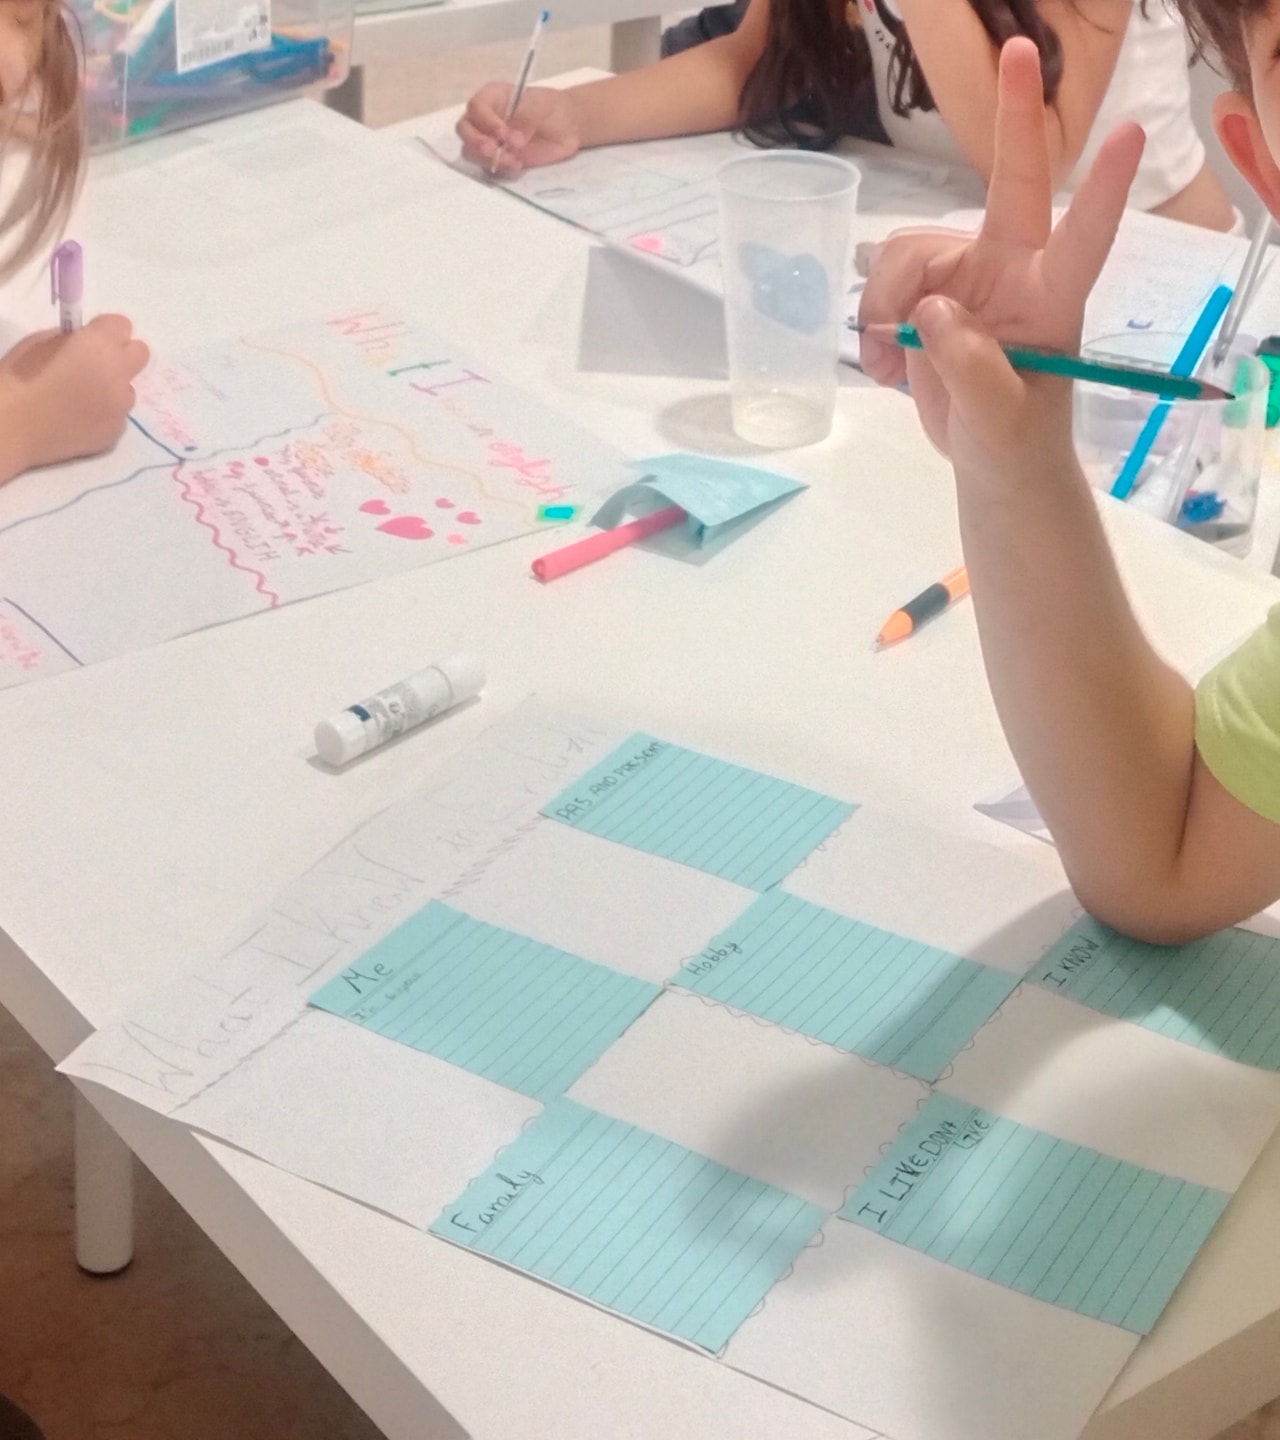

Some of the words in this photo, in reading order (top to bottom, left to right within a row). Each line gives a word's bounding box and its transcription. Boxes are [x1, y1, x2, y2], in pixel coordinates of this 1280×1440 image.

[686, 942, 743, 976] Hobby
[1042, 971, 1067, 988] I
[1057, 935, 1100, 973] KNOW
[341, 963, 394, 994] Me
[450, 1169, 545, 1233] Family
[857, 1202, 888, 1223] I
